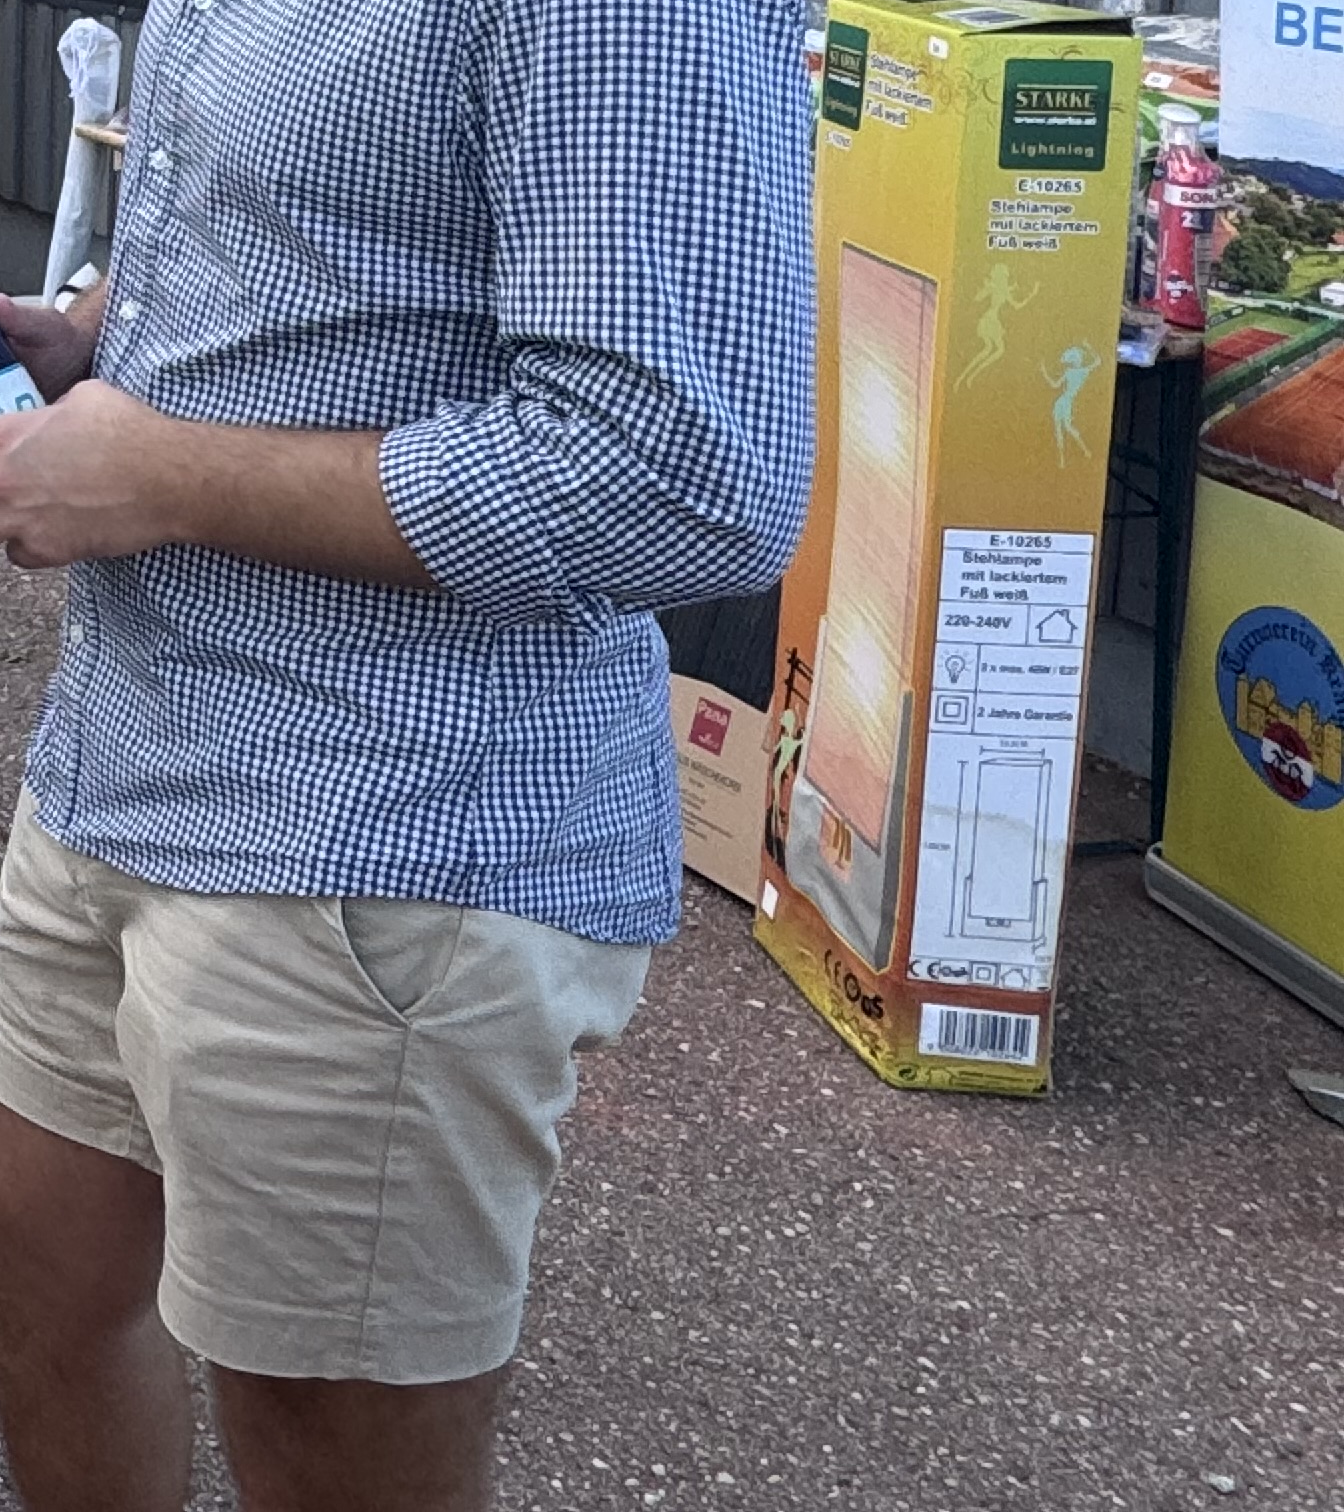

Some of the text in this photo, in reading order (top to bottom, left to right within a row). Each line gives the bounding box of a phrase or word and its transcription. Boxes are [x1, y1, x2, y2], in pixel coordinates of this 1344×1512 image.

[1275, 0, 1344, 54] BE
[1015, 90, 1097, 109] STARKE
[990, 534, 1052, 549] E-10265
[962, 551, 1042, 567] Stehlampe
[961, 570, 1067, 586] mit lackiertem
[944, 614, 1012, 629] 220-240V
